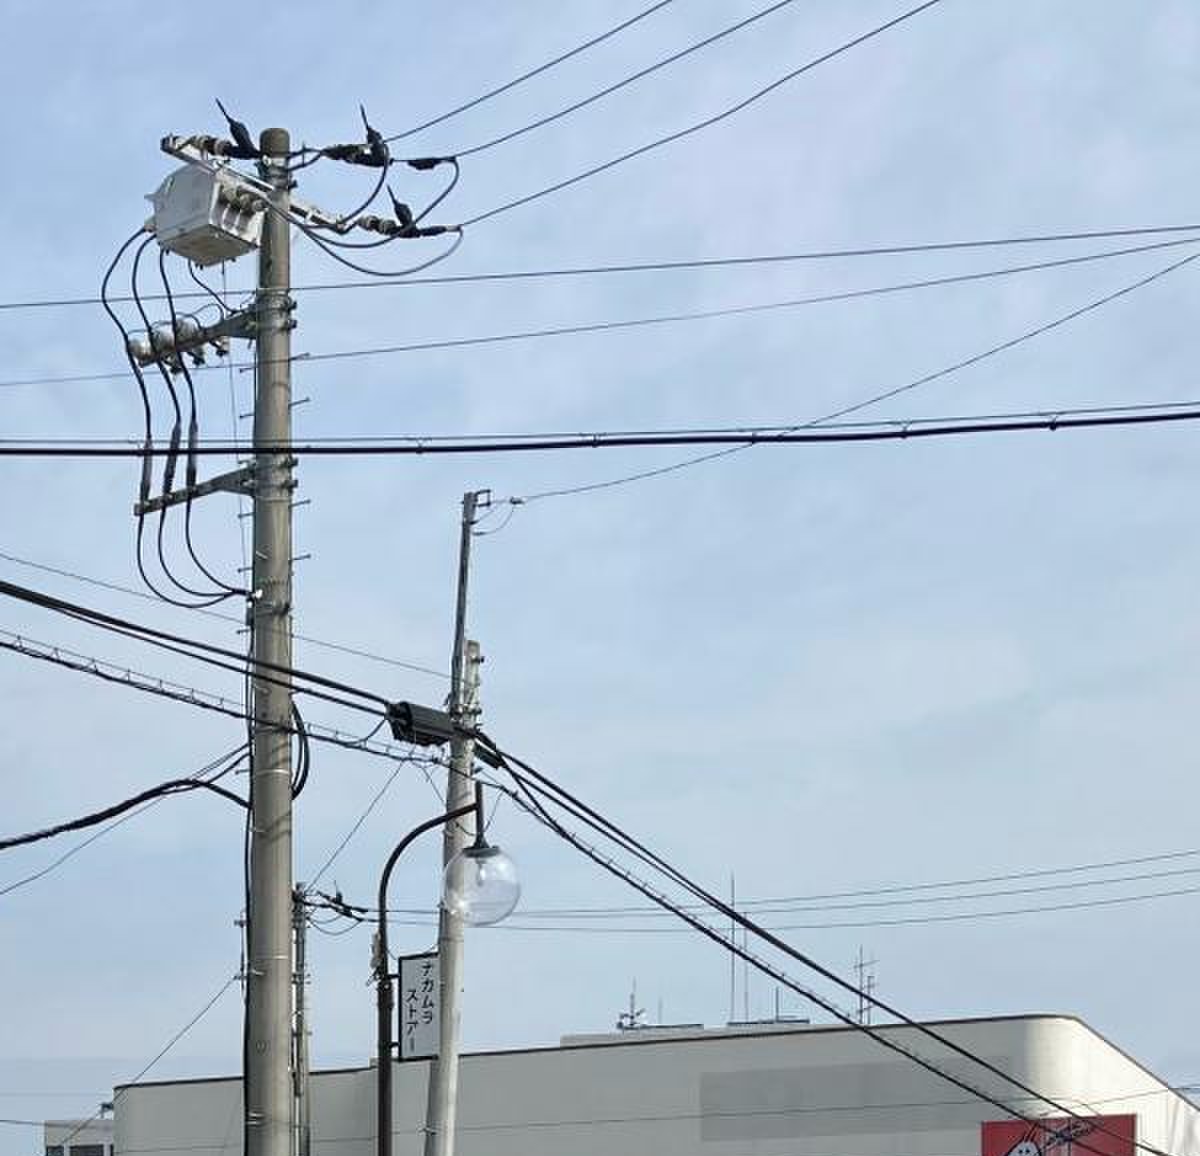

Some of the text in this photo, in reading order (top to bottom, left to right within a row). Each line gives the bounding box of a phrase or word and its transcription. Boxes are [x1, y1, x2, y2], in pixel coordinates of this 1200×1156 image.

[406, 989, 418, 1051] ストアー
[421, 960, 434, 1024] ナカムラ
